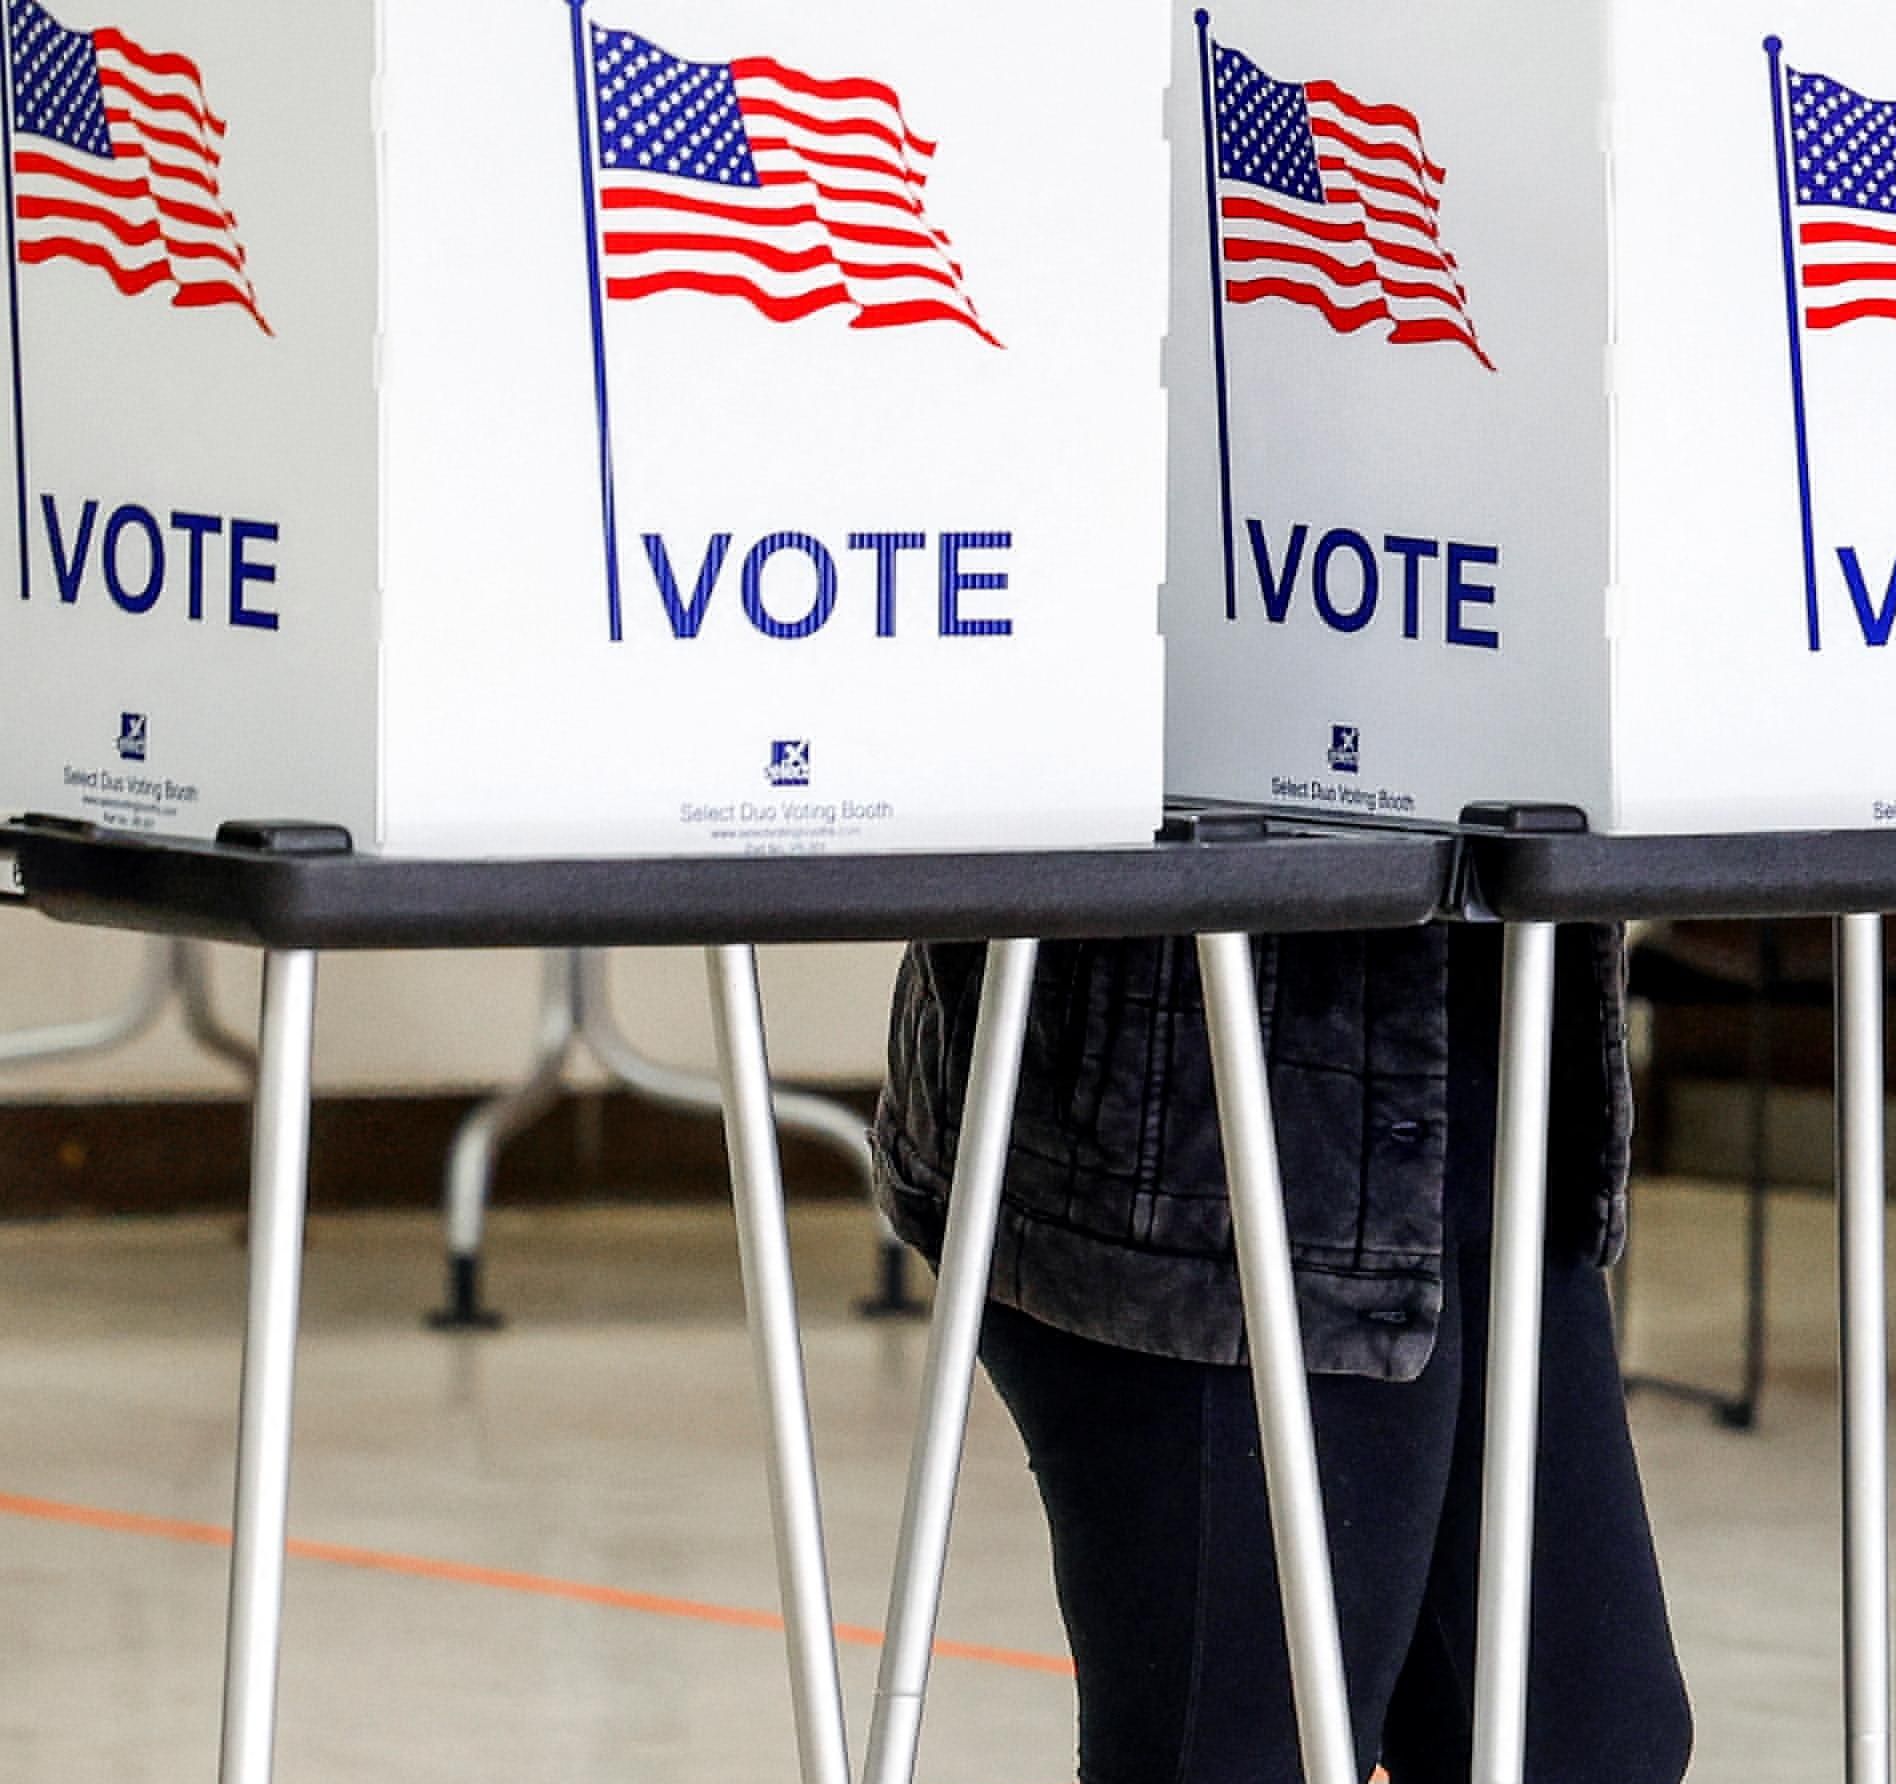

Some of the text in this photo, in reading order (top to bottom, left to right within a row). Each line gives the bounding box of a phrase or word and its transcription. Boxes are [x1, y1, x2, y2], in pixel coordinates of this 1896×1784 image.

[42, 493, 280, 630] VOTE
[643, 531, 1012, 640] VOTE
[1249, 519, 1498, 648] VOTE
[680, 800, 894, 824] Select Duo Voting Booth
